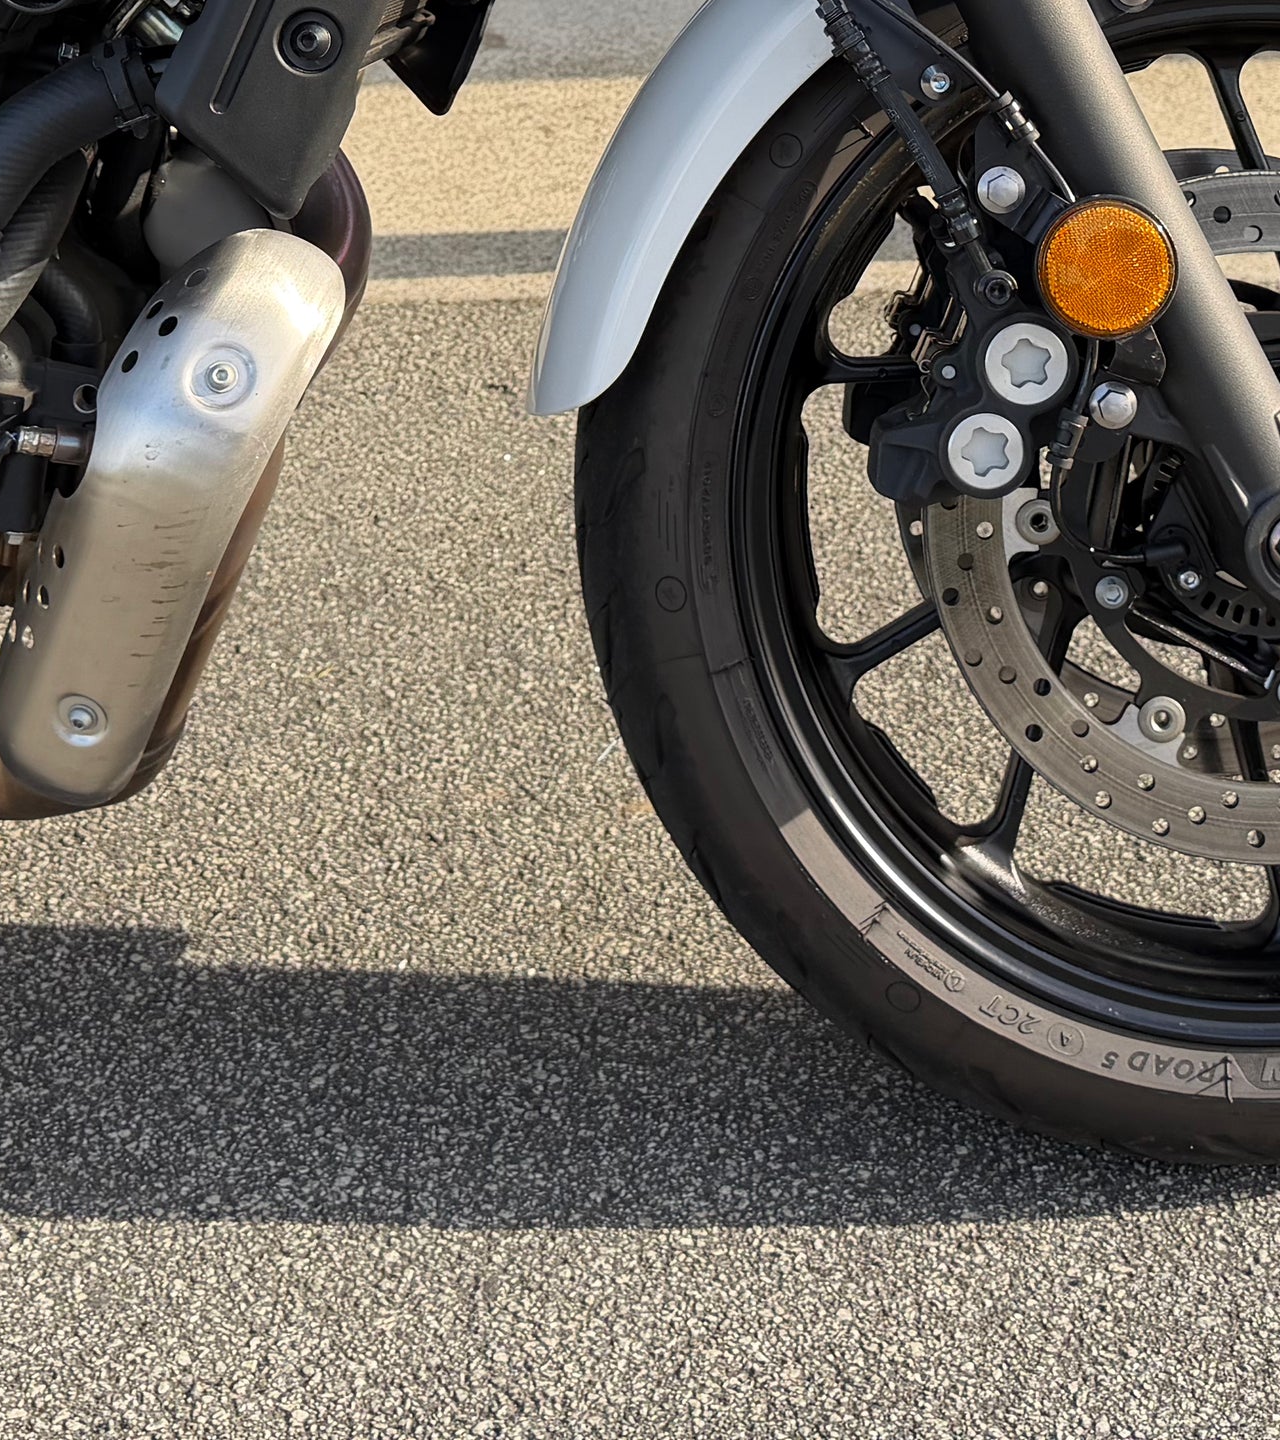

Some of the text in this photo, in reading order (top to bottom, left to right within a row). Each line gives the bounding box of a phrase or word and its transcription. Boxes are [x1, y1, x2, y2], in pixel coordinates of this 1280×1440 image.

[979, 994, 1042, 1035] 2CT
[1101, 1050, 1120, 1070] 5
[1127, 1051, 1217, 1083] ROAD
